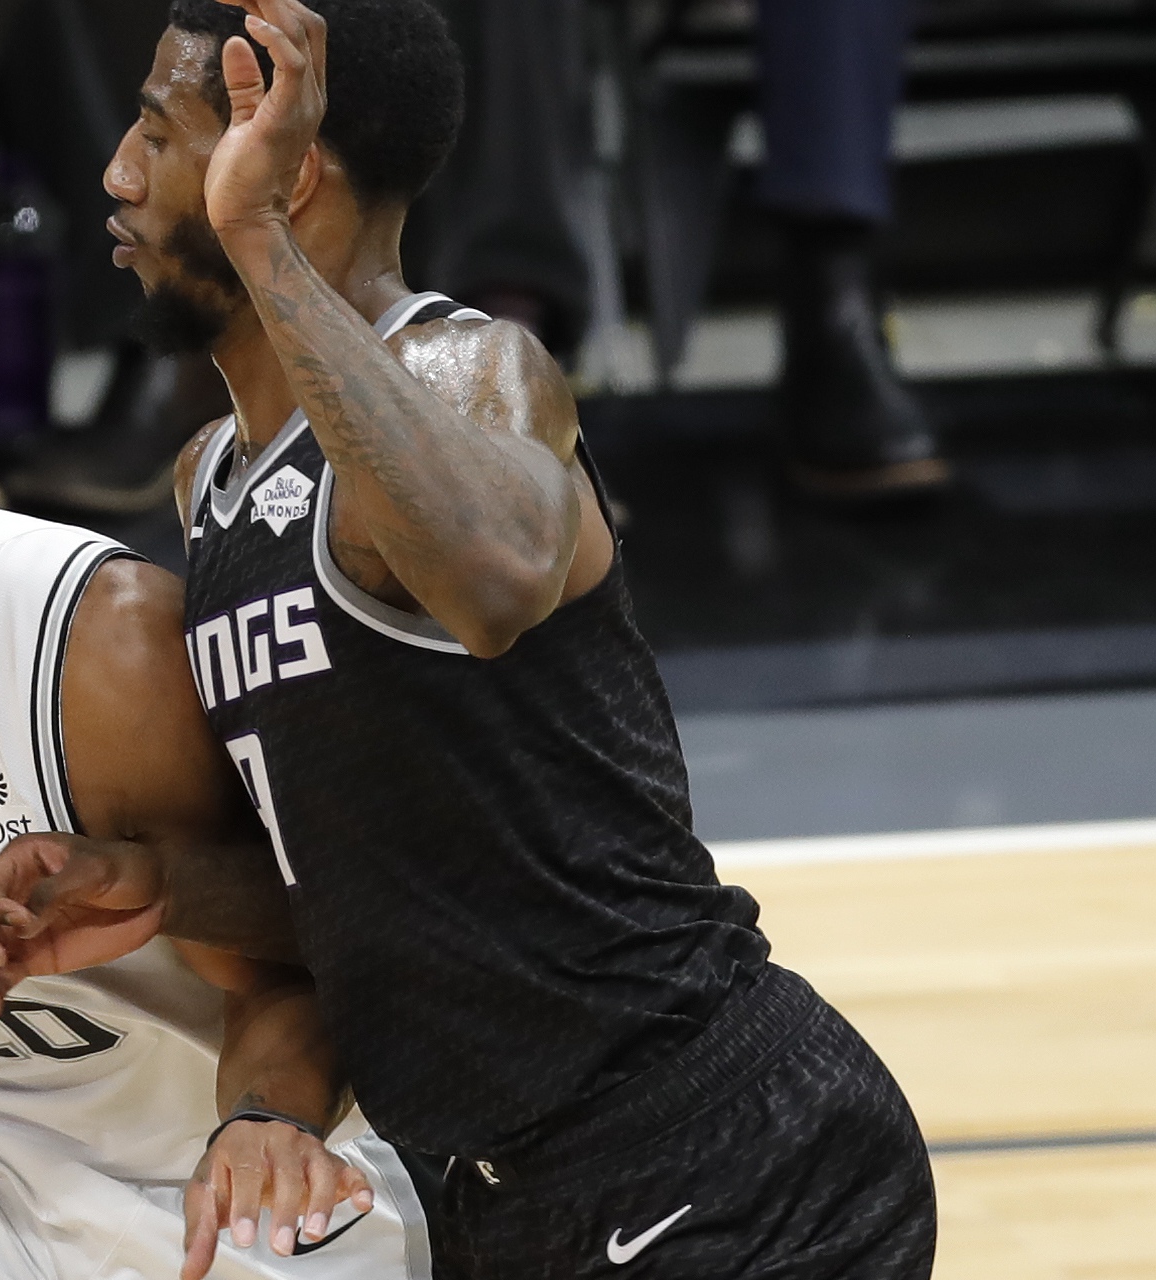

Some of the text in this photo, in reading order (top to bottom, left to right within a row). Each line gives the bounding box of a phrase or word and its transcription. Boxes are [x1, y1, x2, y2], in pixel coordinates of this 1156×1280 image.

[264, 485, 303, 502] DIAMOND
[252, 502, 308, 520] ALMONDS
[185, 586, 333, 715] NGS
